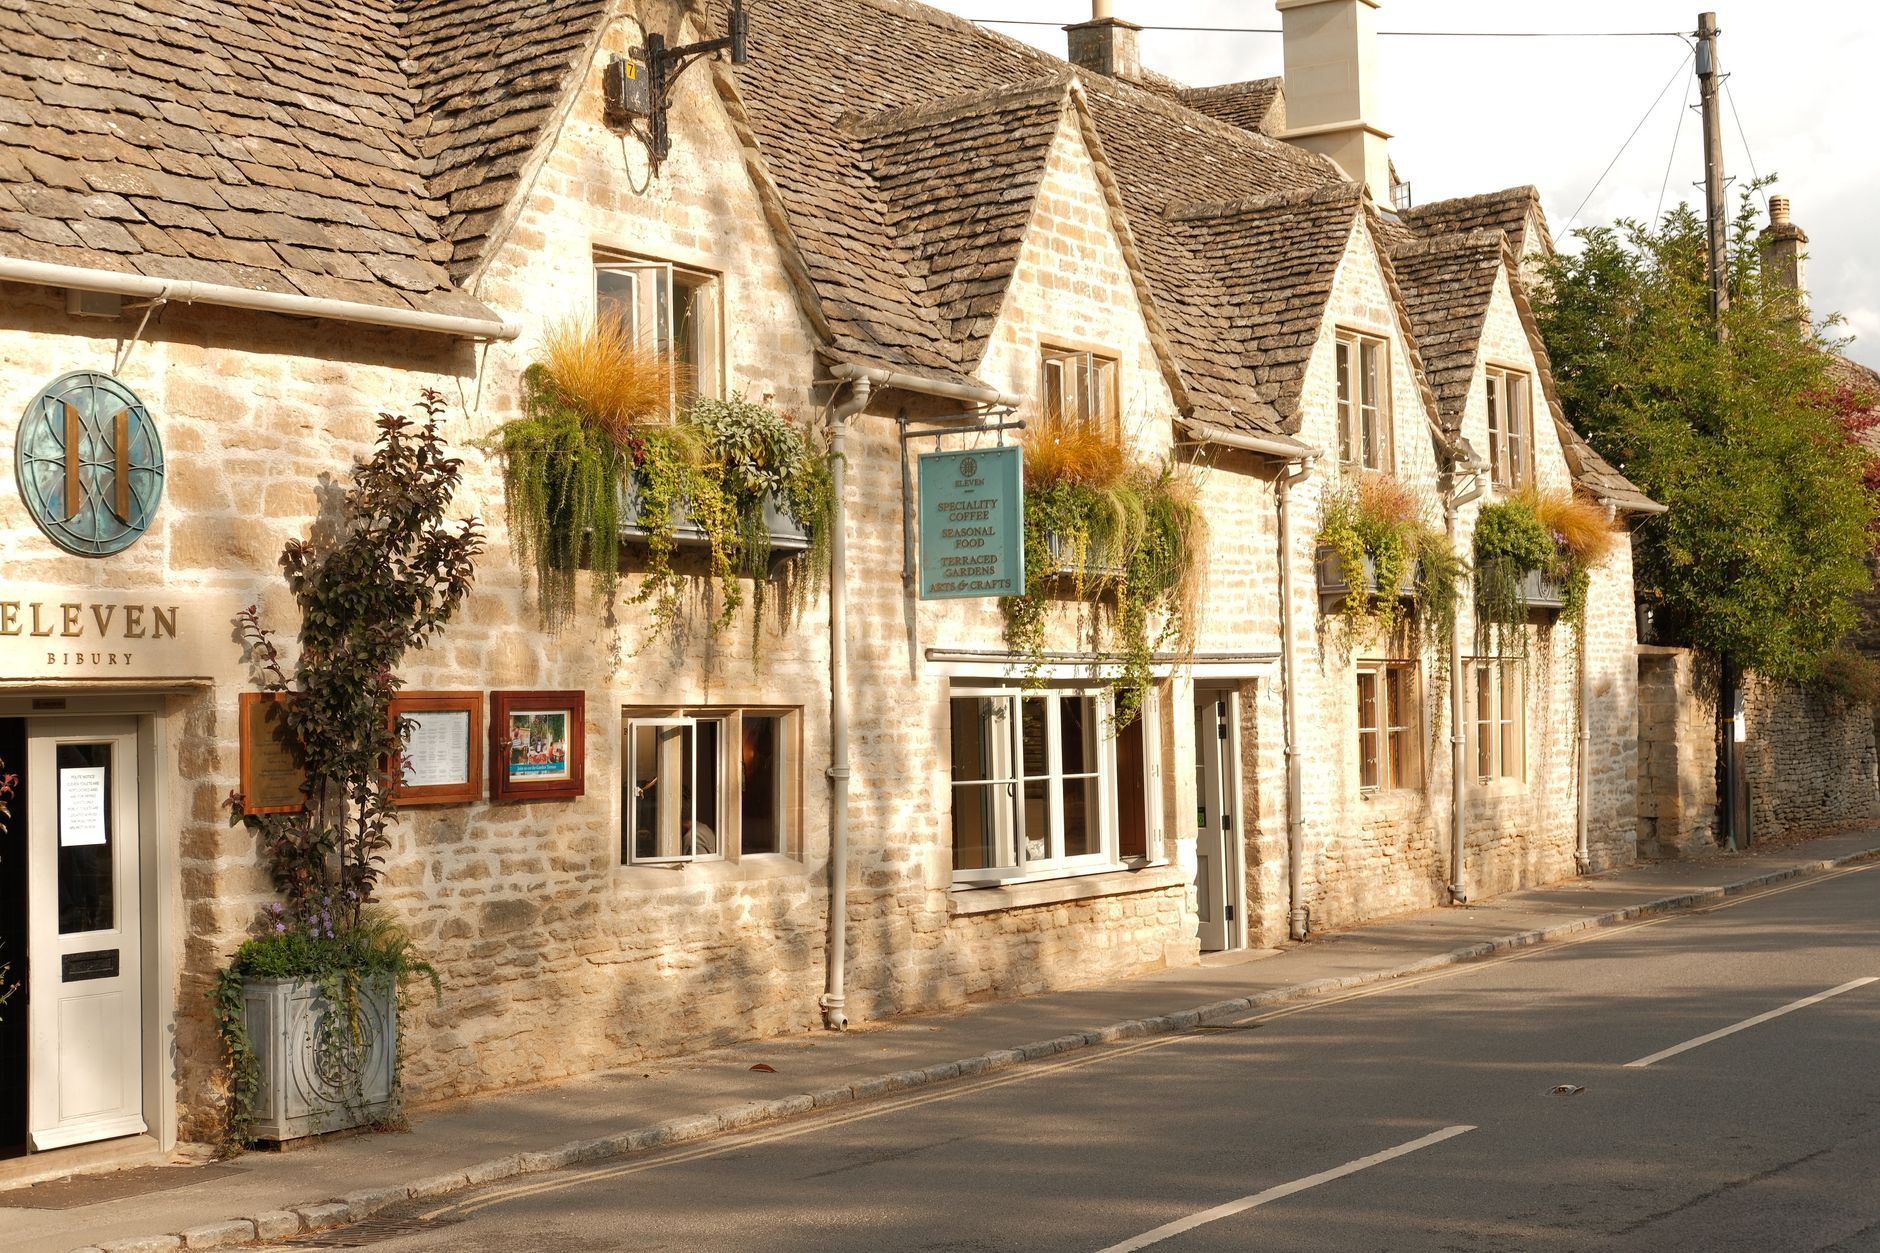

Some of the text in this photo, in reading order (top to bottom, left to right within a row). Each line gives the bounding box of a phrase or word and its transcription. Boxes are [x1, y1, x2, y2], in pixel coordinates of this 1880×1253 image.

[628, 63, 634, 76] 7
[955, 478, 985, 488] ELEVEN
[937, 499, 998, 512] SPECIALITY
[949, 511, 989, 522] COFFEE
[942, 526, 995, 538] SEASONAL
[956, 538, 985, 548] FOOD
[941, 554, 998, 567] TERRACED
[944, 566, 995, 577] GARDENS
[929, 579, 1011, 593] ARTS & CRAFTS
[0, 601, 179, 640] ELEVEN
[47, 652, 133, 665] BIBURY
